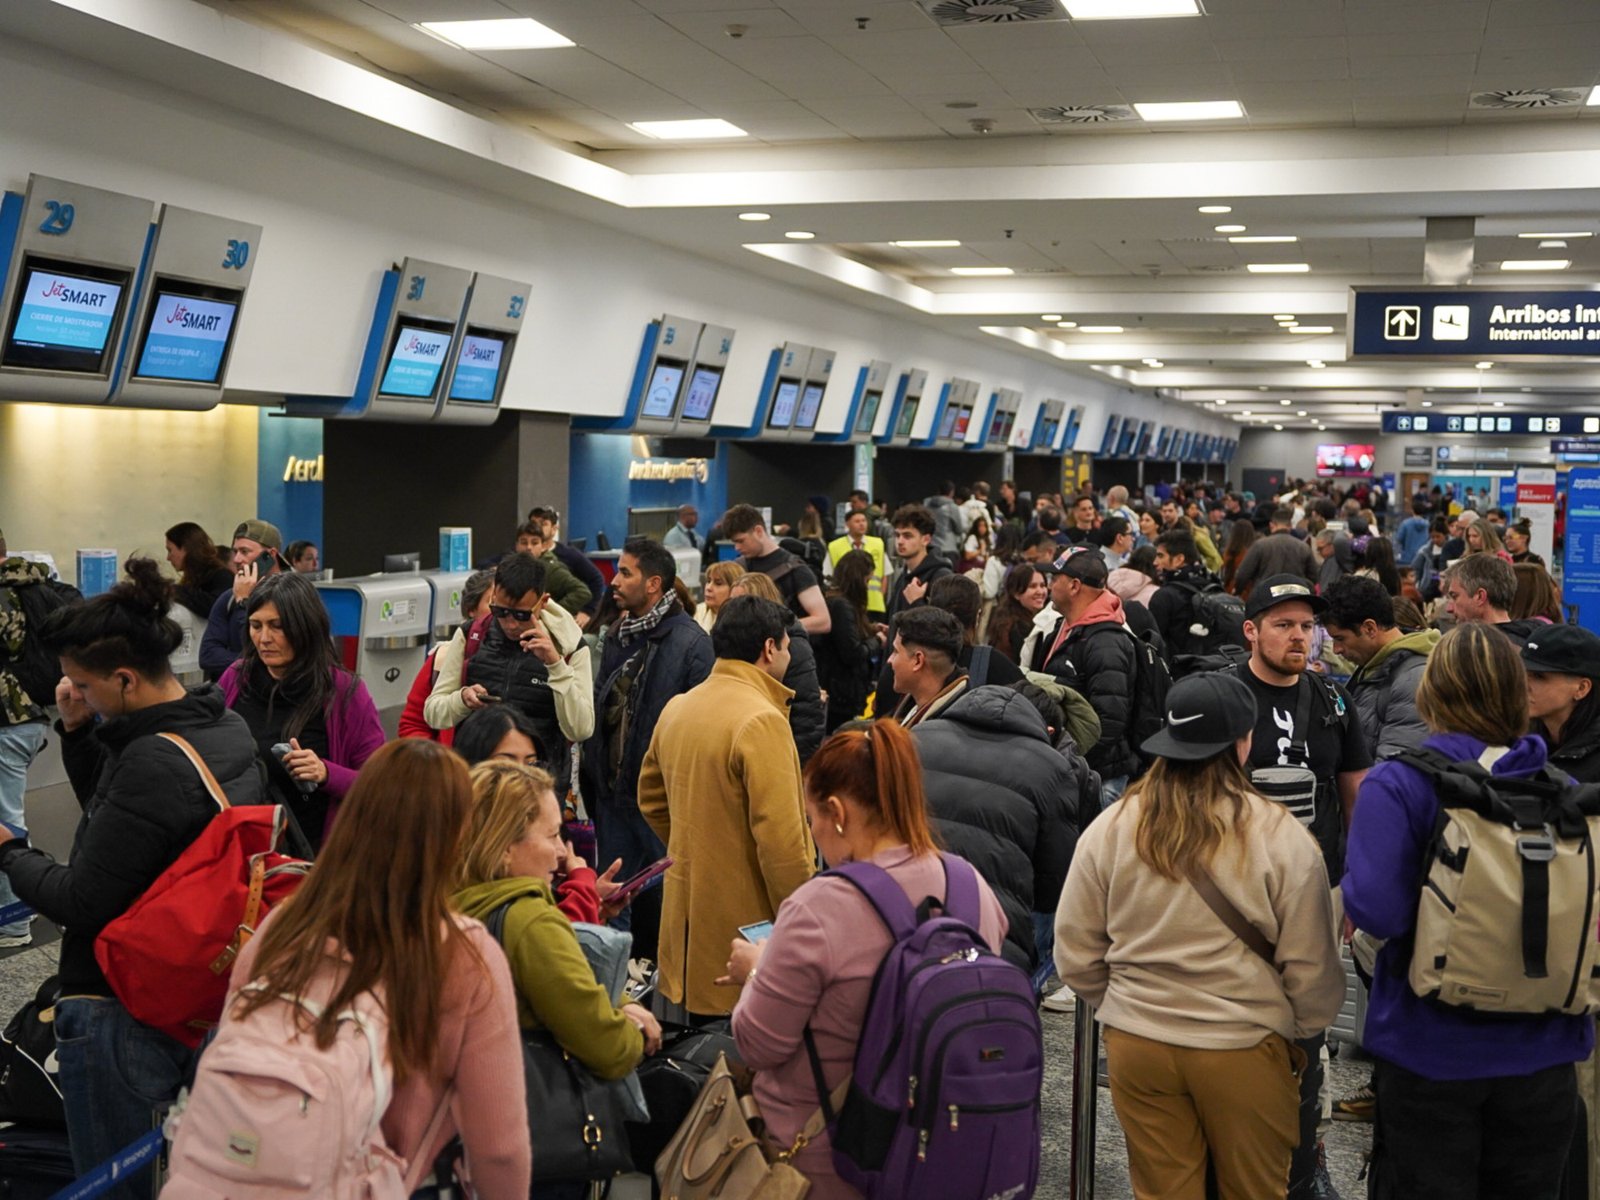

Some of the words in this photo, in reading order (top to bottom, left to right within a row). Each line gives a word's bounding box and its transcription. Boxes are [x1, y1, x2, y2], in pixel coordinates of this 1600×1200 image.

[39, 200, 75, 235] 29
[222, 239, 249, 270] 30
[42, 281, 107, 307] JetSMART
[406, 275, 426, 301] 31
[166, 303, 221, 331] JetSMART
[1490, 304, 1571, 323] Arribos
[1490, 327, 1584, 340] International
